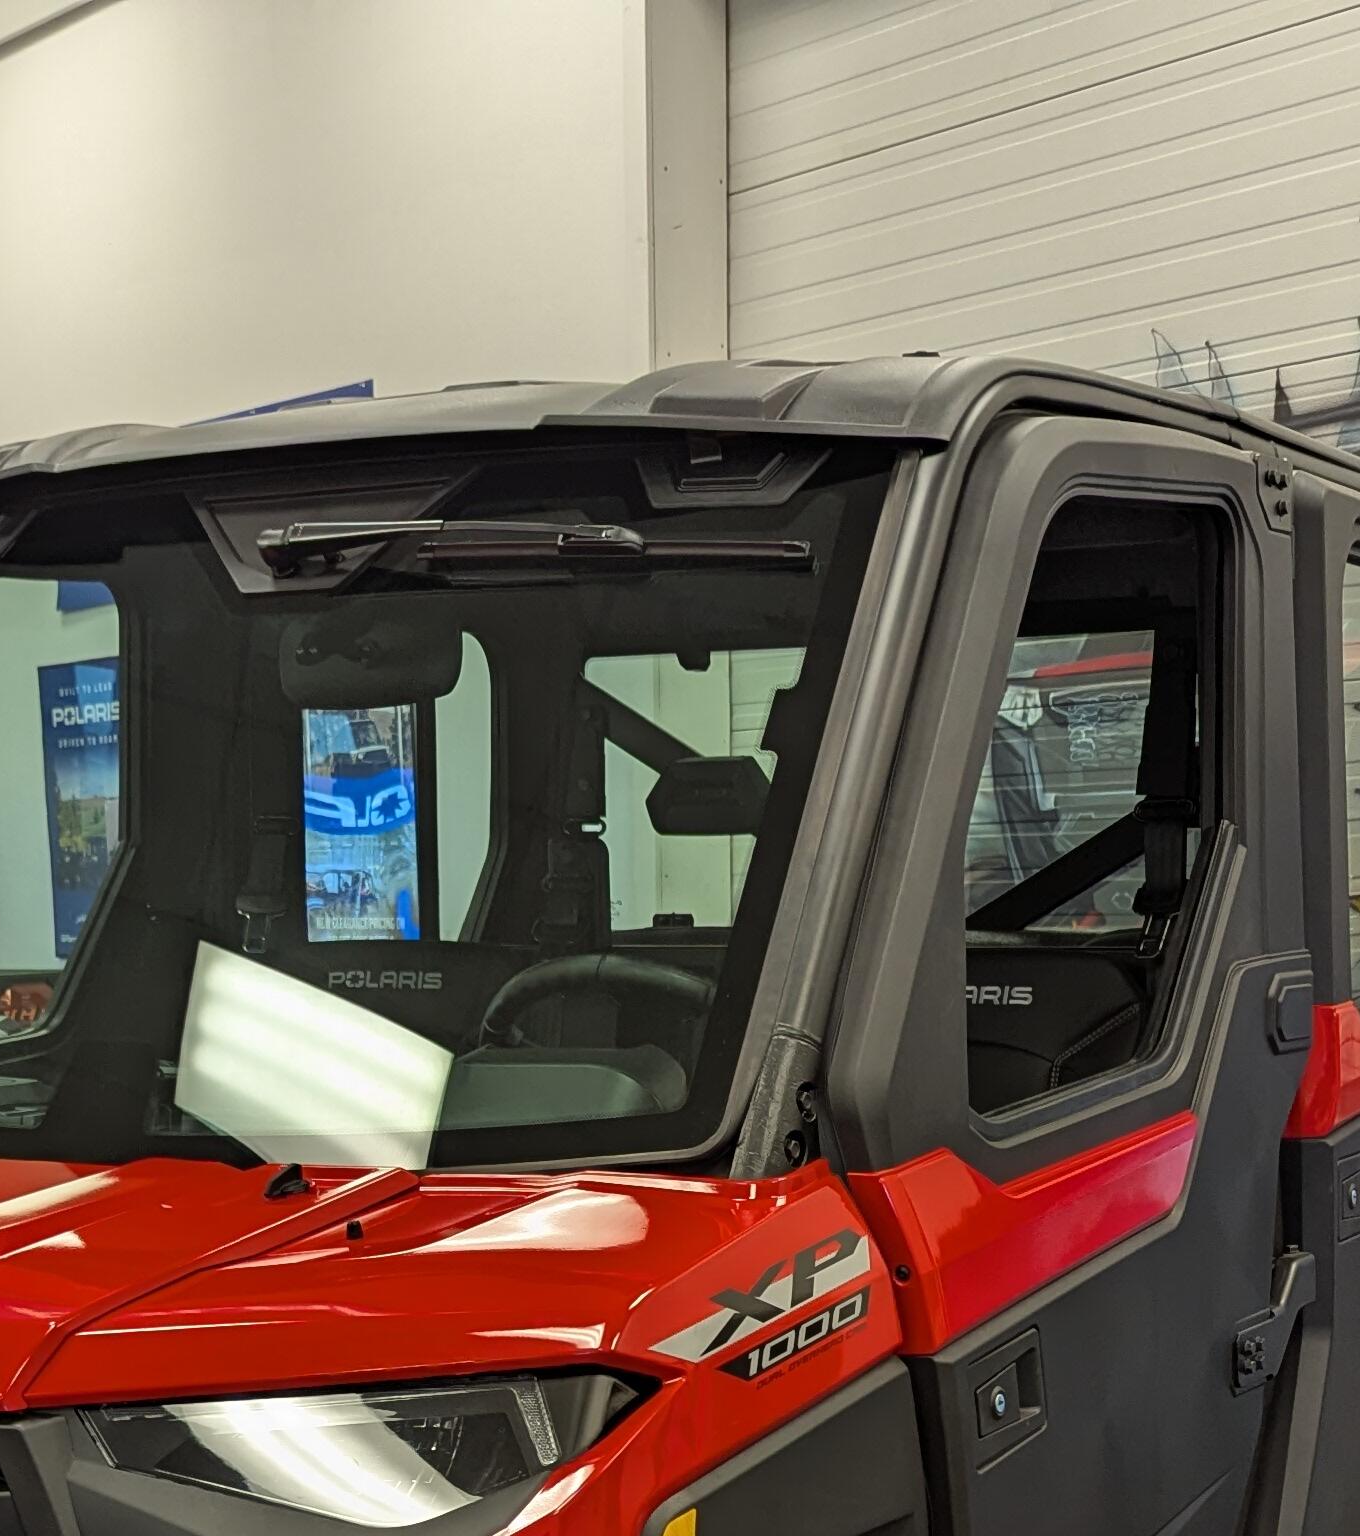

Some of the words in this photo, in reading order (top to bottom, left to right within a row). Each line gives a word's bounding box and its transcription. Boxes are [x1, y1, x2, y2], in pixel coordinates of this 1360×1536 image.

[51, 701, 120, 728] POLARIS
[327, 970, 443, 990] POLARIS
[965, 985, 1033, 1006] ARIS
[698, 1227, 863, 1358] XP
[747, 1292, 863, 1377] 1000
